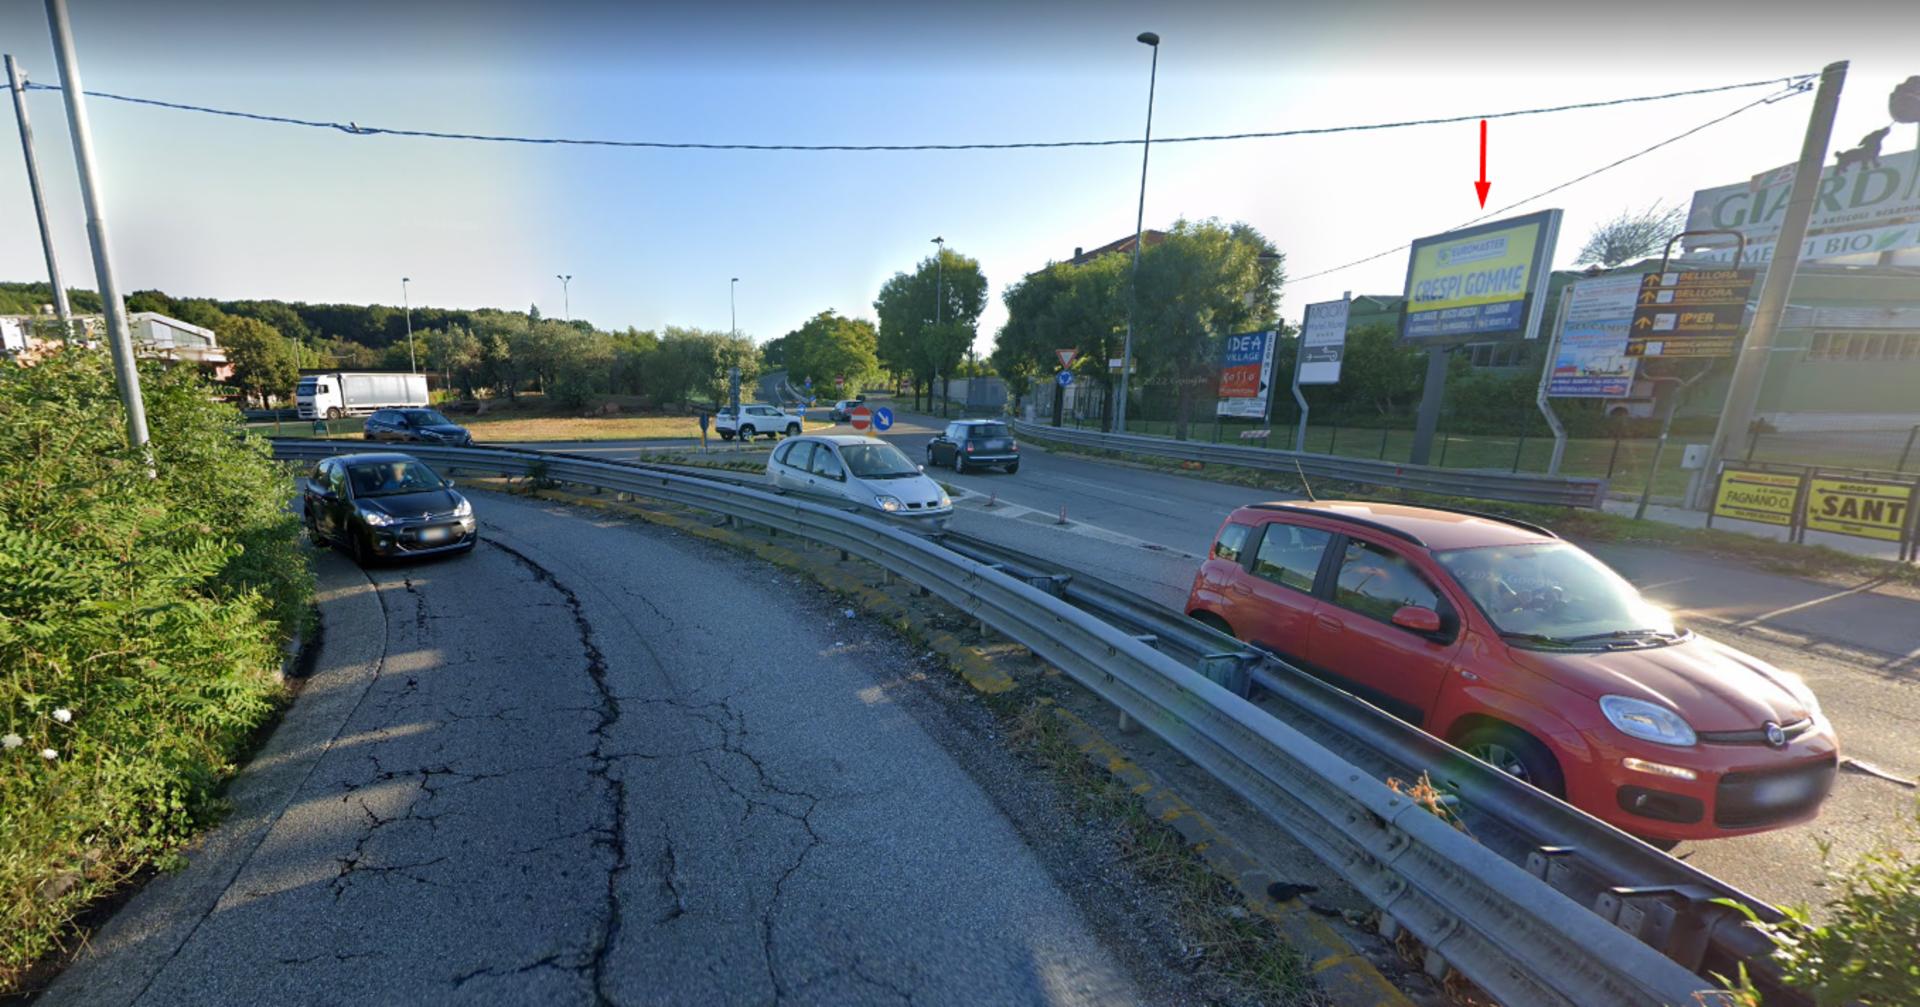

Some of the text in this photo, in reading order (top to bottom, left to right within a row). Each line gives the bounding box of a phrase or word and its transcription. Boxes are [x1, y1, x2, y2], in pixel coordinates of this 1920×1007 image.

[1450, 238, 1505, 257] EUROMASTER
[1824, 233, 1873, 255] BIO
[1414, 264, 1525, 304] CRESPI GOMME
[1227, 336, 1262, 352] IDEA
[1226, 352, 1261, 361] VILLAGE
[1727, 490, 1778, 507] FAGNANO
[1822, 494, 1905, 524] SANT
